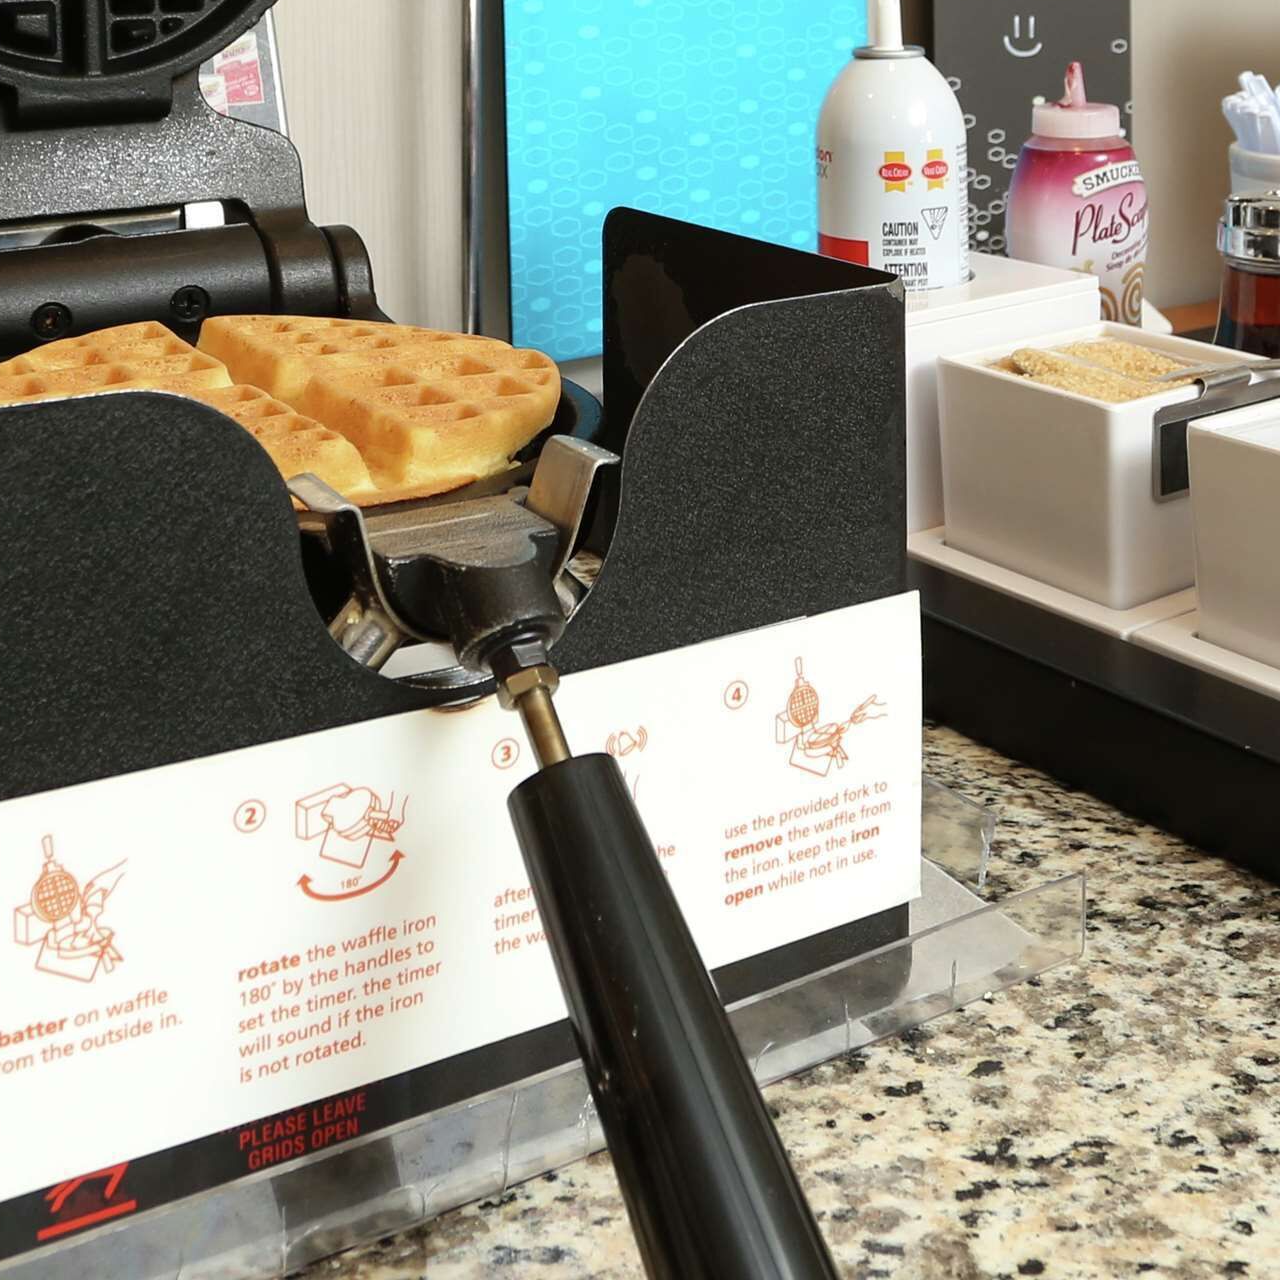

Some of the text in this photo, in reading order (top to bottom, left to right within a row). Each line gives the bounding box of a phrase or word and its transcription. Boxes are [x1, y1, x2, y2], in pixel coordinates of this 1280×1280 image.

[882, 221, 919, 237] CAUTION
[884, 262, 928, 277] ATTENTION
[724, 781, 888, 840] use the provided fork to
[724, 801, 892, 862] remove the waffle from
[656, 843, 676, 858] he
[724, 825, 880, 884] the iron. keep the iron
[724, 848, 878, 907] open while not in use.
[493, 907, 539, 931] timer
[494, 937, 521, 955] the
[237, 914, 437, 983] rotate the waffle iron
[282, 977, 304, 996] by
[309, 967, 339, 987] the
[344, 948, 412, 977] handles
[417, 939, 434, 957] to
[73, 1008, 99, 1027] on
[106, 988, 169, 1019] waffle
[238, 961, 443, 1034] set the timer. the timer
[238, 991, 424, 1058] will sound if the iron
[41, 1040, 75, 1064] the
[81, 1019, 153, 1052] outside
[160, 1012, 183, 1031] in.
[239, 1031, 366, 1083] is not rotated.
[239, 1092, 367, 1151] PLEASE LEAVE
[248, 1117, 360, 1170] GRIDS OPEN
